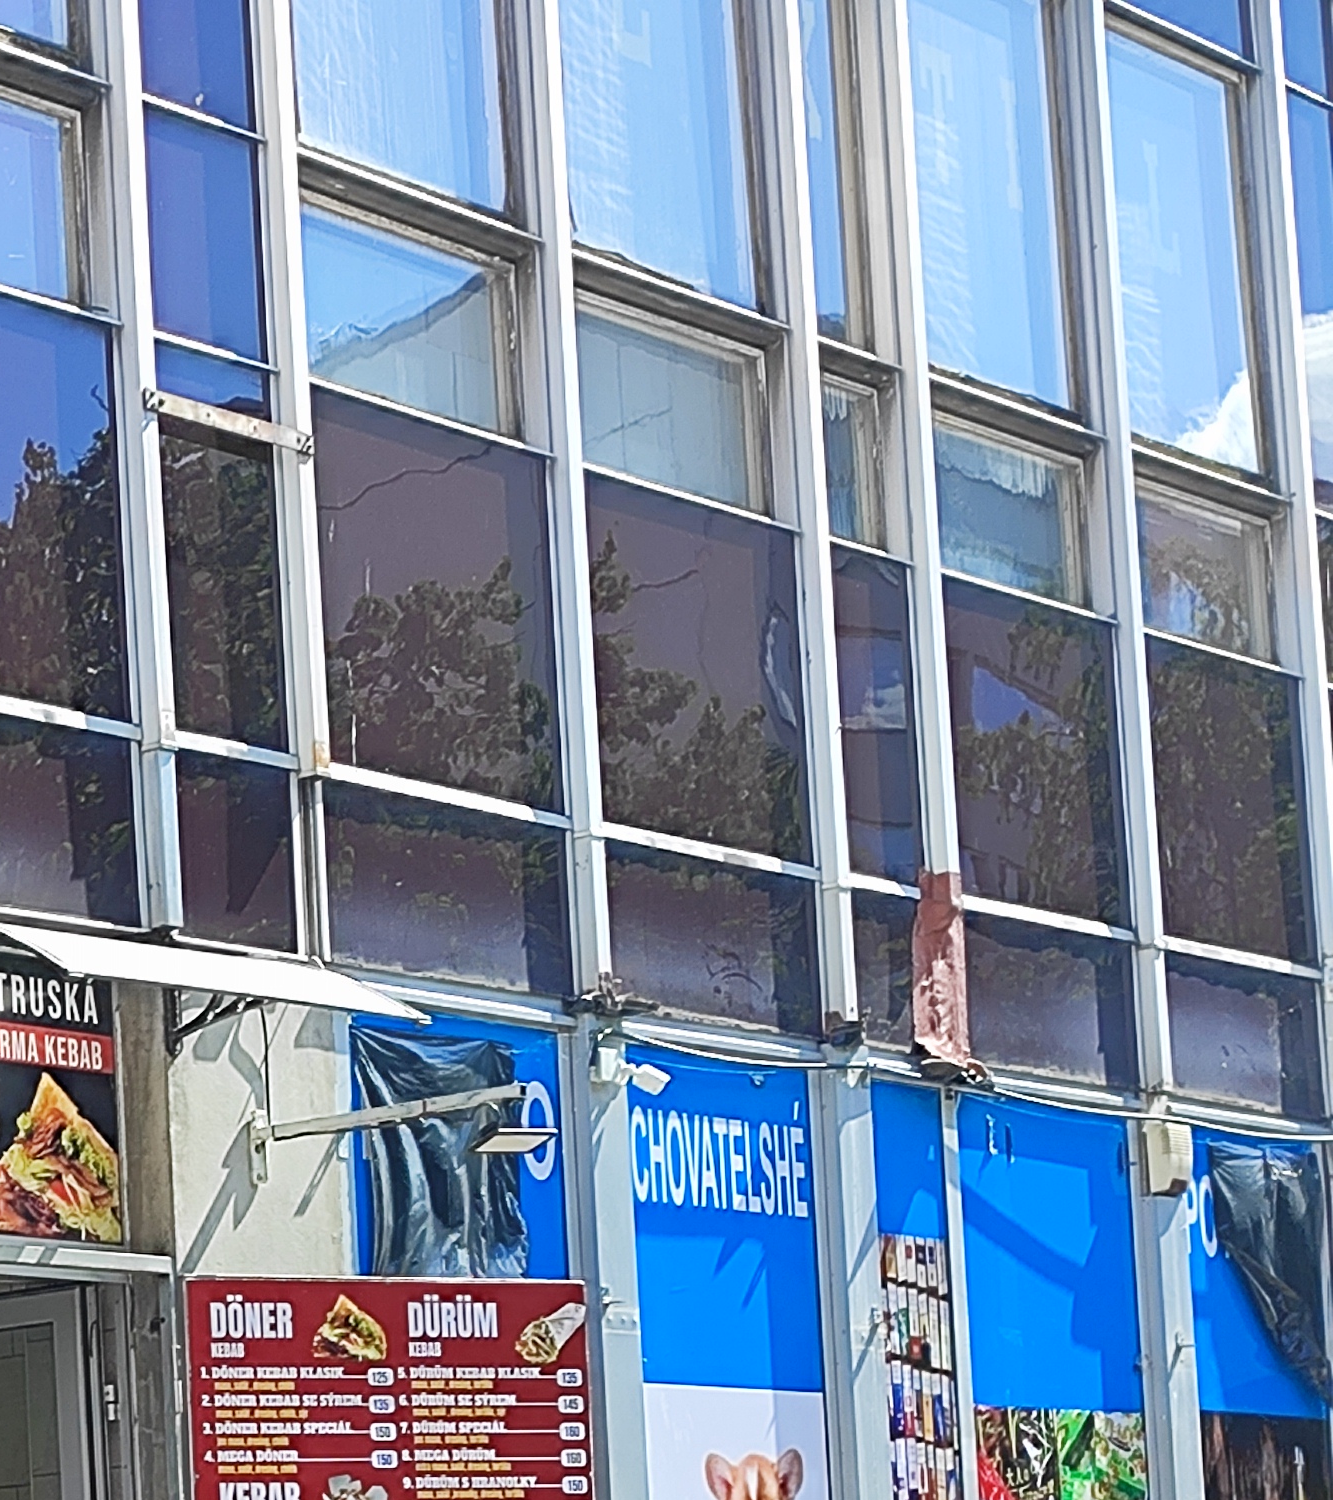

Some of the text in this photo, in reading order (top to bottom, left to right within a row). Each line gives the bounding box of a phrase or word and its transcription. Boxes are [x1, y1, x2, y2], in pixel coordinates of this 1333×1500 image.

[44, 1034, 103, 1071] KEBAB
[210, 1294, 293, 1339] DÖNER
[408, 1294, 498, 1338] DÜRÜM
[562, 1372, 578, 1384] 135
[568, 1479, 583, 1491] 150
